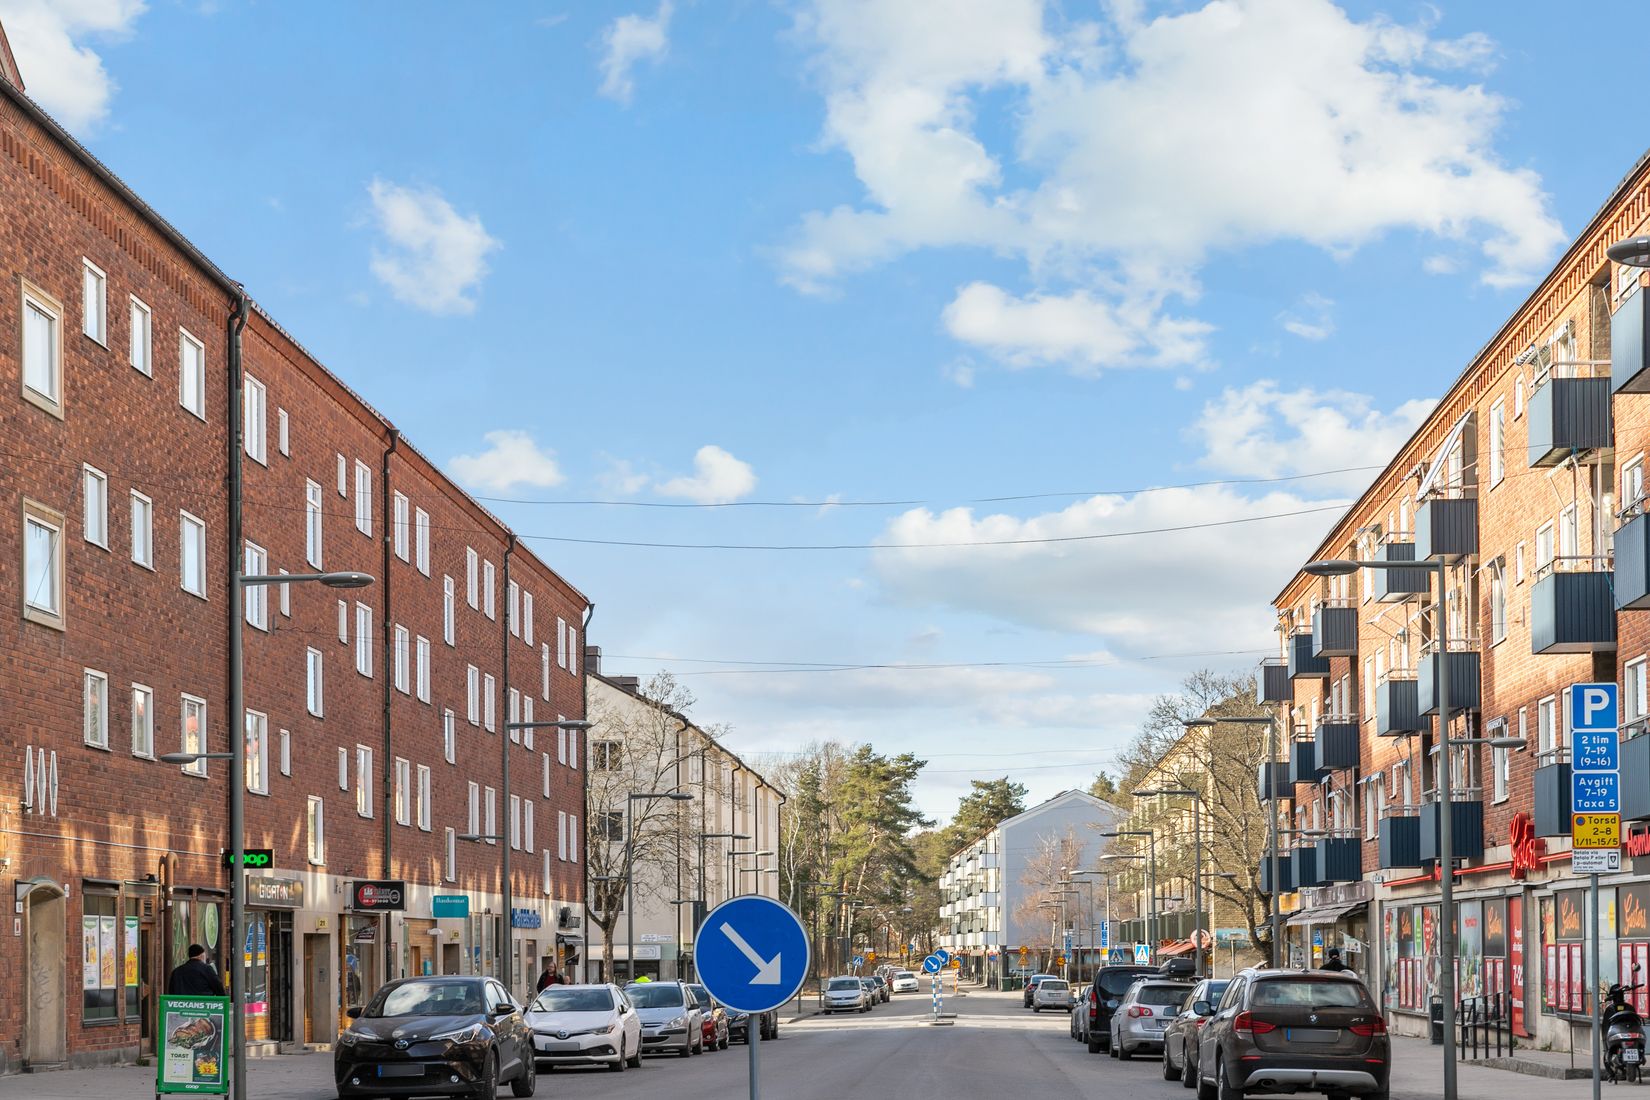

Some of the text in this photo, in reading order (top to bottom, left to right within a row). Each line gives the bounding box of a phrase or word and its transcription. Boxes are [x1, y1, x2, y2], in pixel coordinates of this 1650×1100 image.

[1584, 688, 1610, 725] P
[1581, 735, 1609, 744] 2 tim
[1584, 746, 1607, 755] 7-19
[1580, 756, 1611, 766] (9-16)
[1578, 777, 1613, 787] Avgift
[1585, 788, 1607, 796] 7-19
[1577, 799, 1615, 807] Taxa 5
[1588, 816, 1616, 824] Torsd
[1592, 827, 1612, 835] 2-8
[1576, 838, 1618, 846] 1/11-15/5
[167, 1001, 224, 1010] VECKANS TIPS
